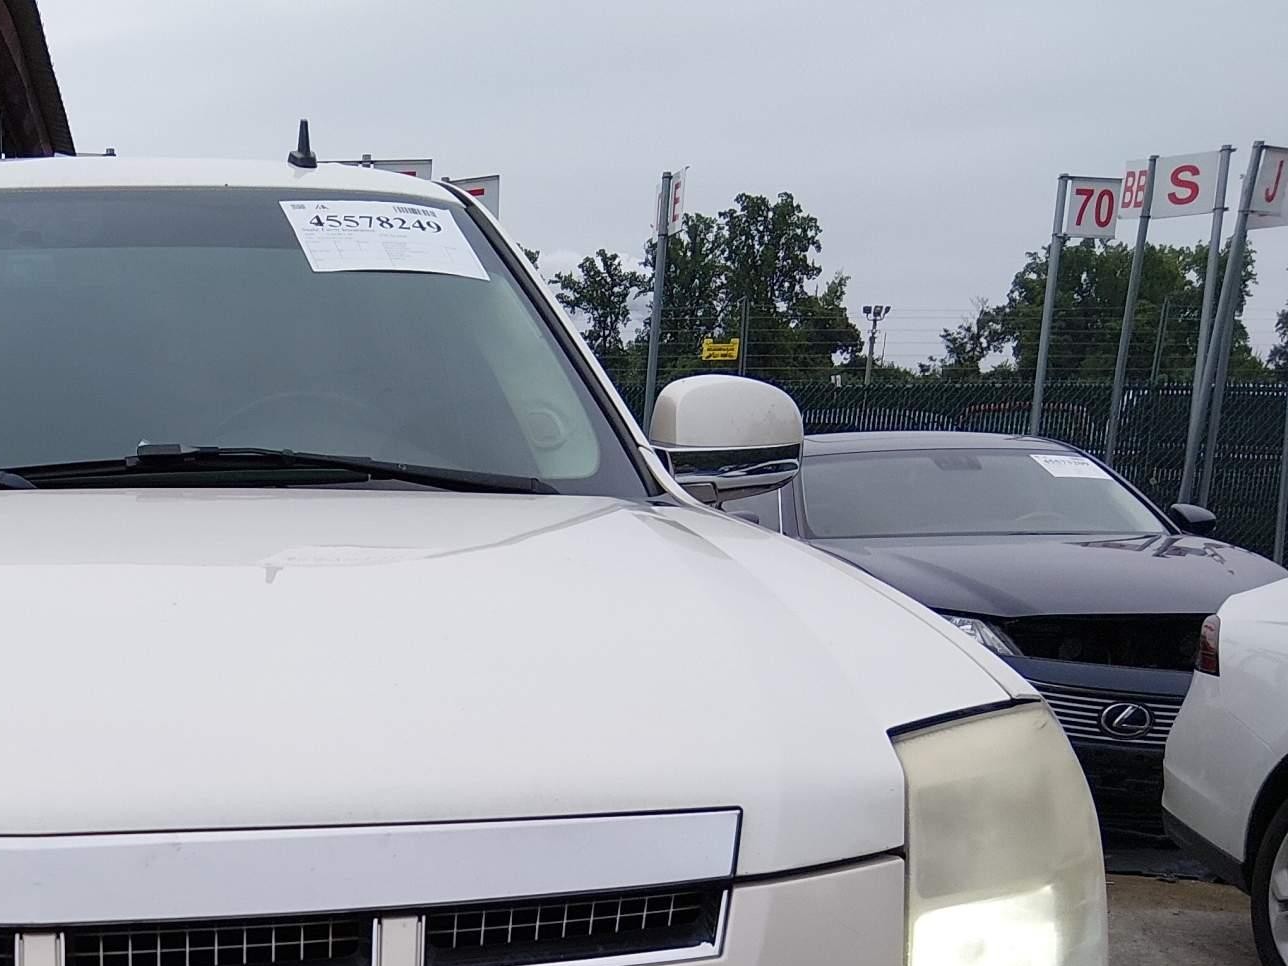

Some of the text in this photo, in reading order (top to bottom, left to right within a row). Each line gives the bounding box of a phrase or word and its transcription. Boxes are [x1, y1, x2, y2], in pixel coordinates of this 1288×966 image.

[672, 180, 682, 223] E
[1167, 164, 1201, 206] S
[1264, 159, 1285, 204] J
[309, 214, 443, 234] 45578249
[1075, 188, 1115, 228] 70
